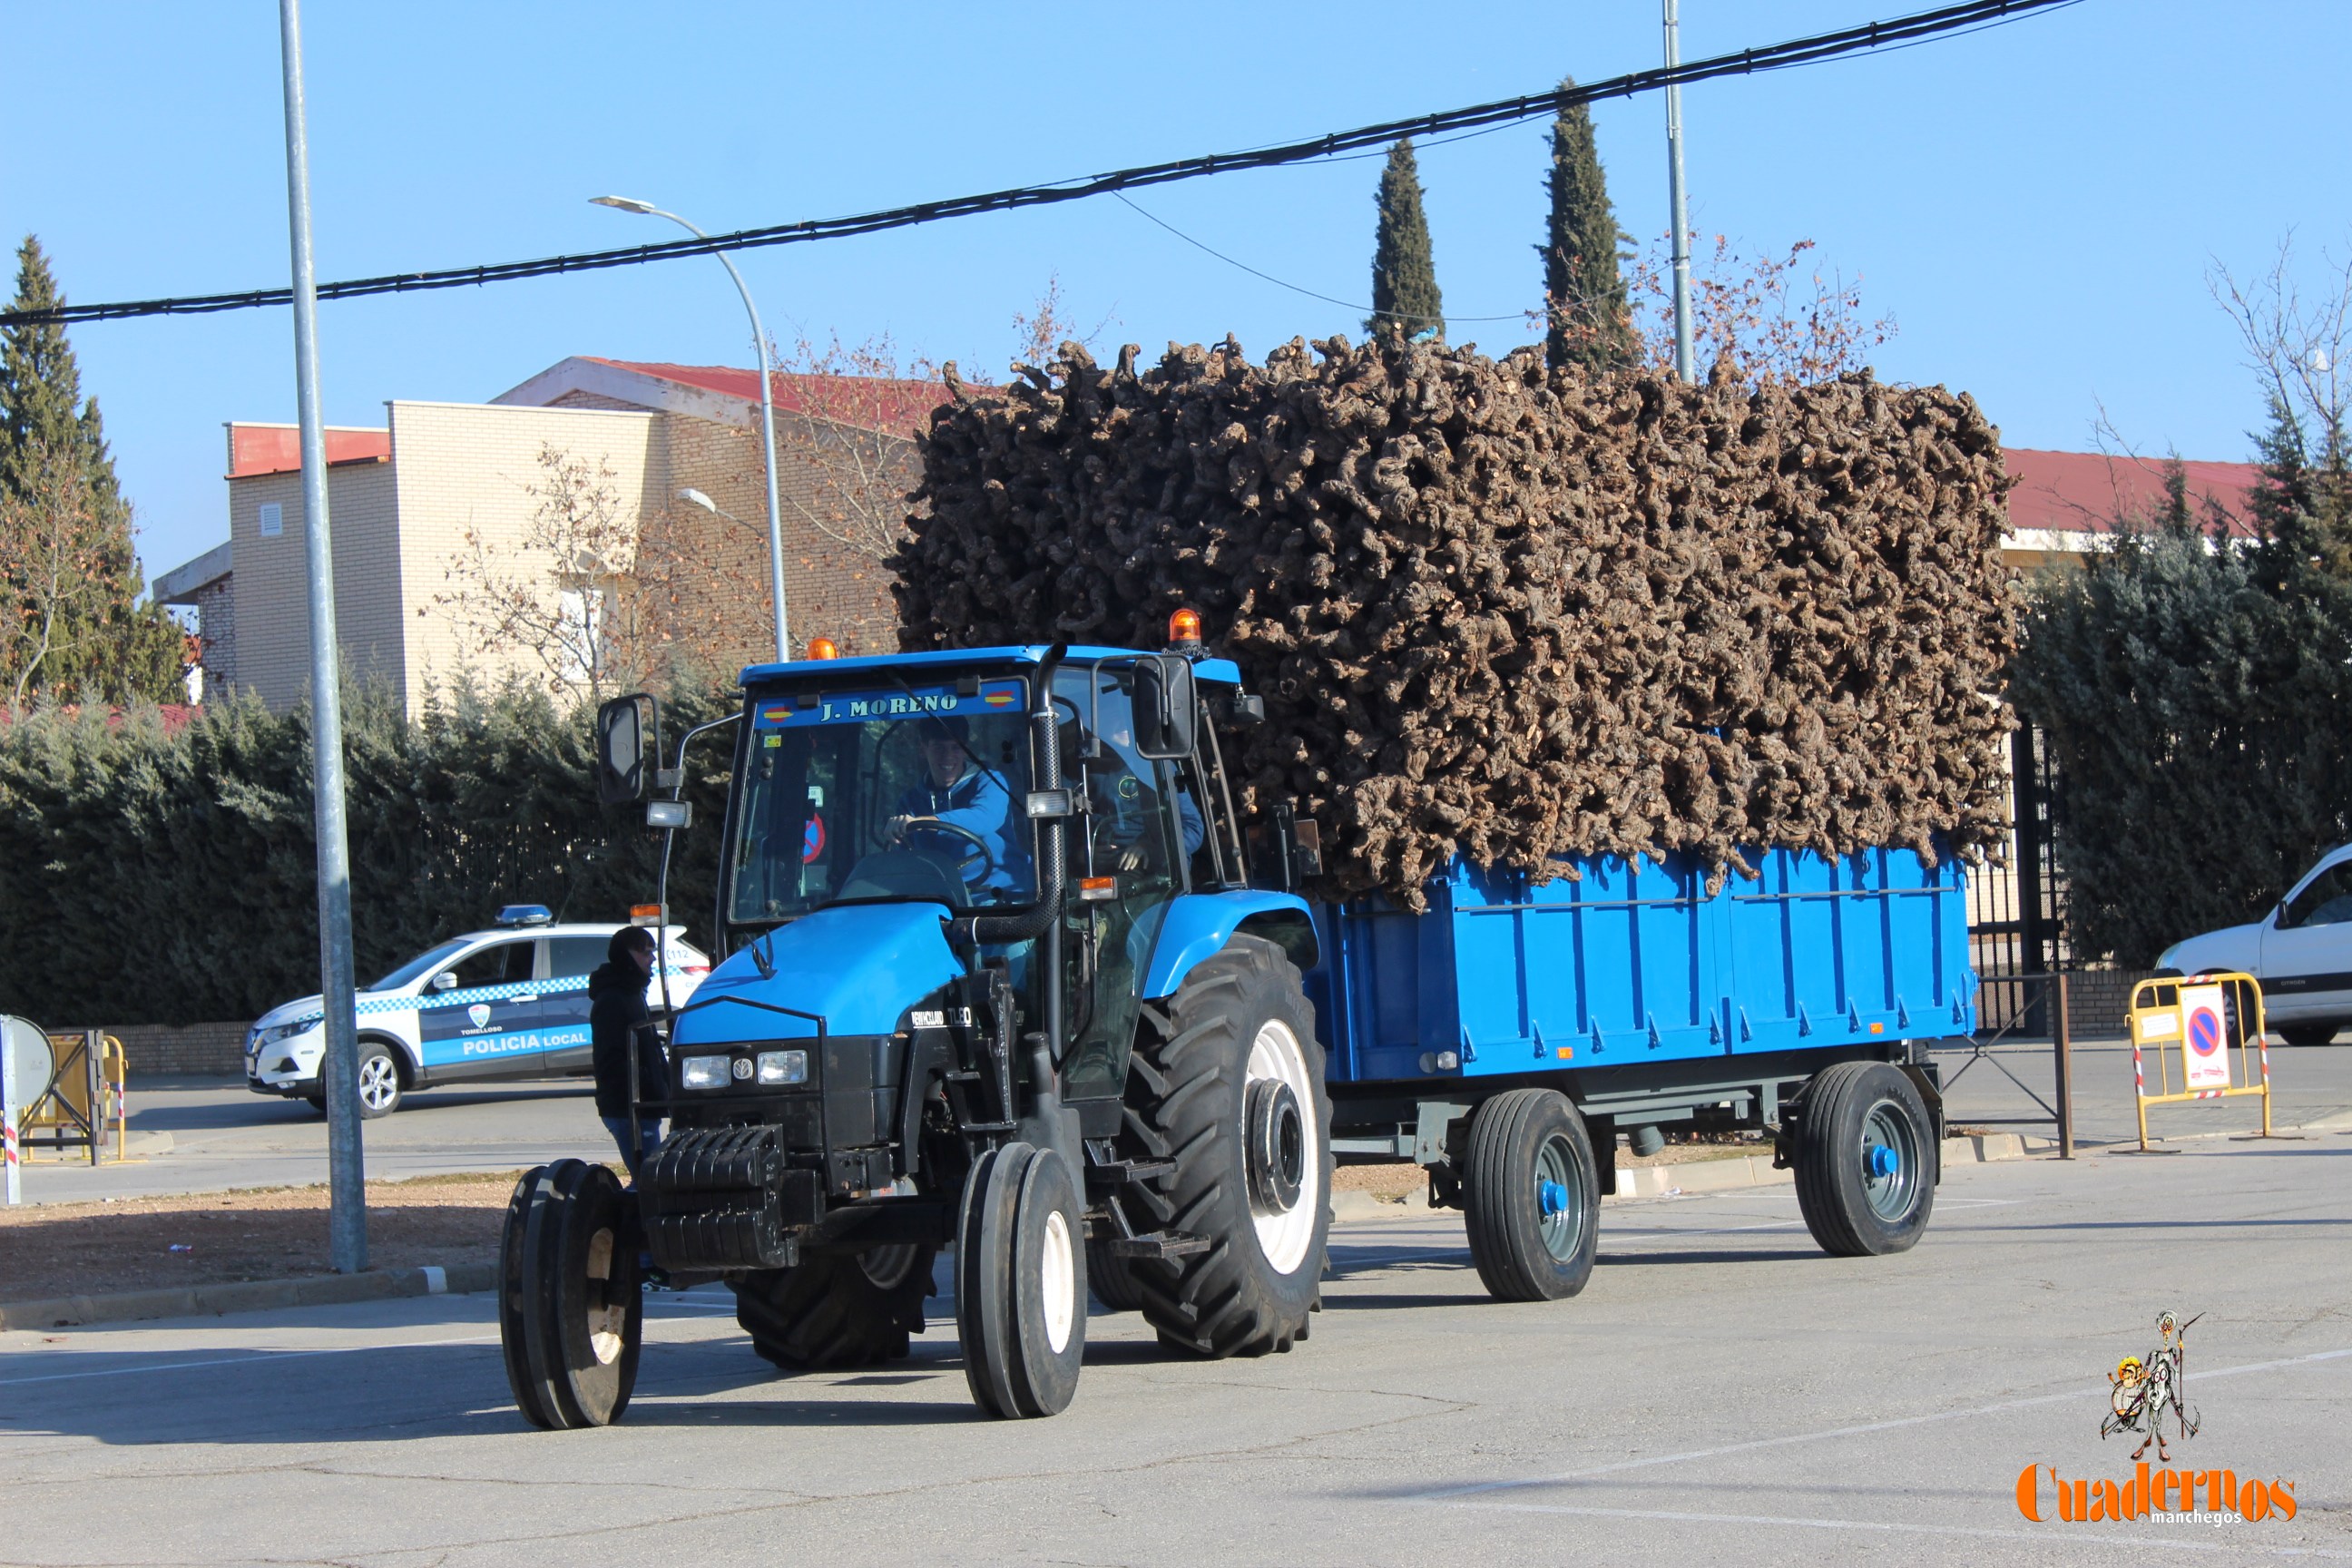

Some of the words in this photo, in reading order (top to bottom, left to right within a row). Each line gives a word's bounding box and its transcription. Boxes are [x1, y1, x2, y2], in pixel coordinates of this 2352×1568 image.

[821, 703, 841, 722] J.
[849, 694, 957, 718] MORENO
[461, 1025, 503, 1036] TOMELLOSO
[463, 1034, 541, 1055] POLICIA
[543, 1033, 587, 1047] LOCAL
